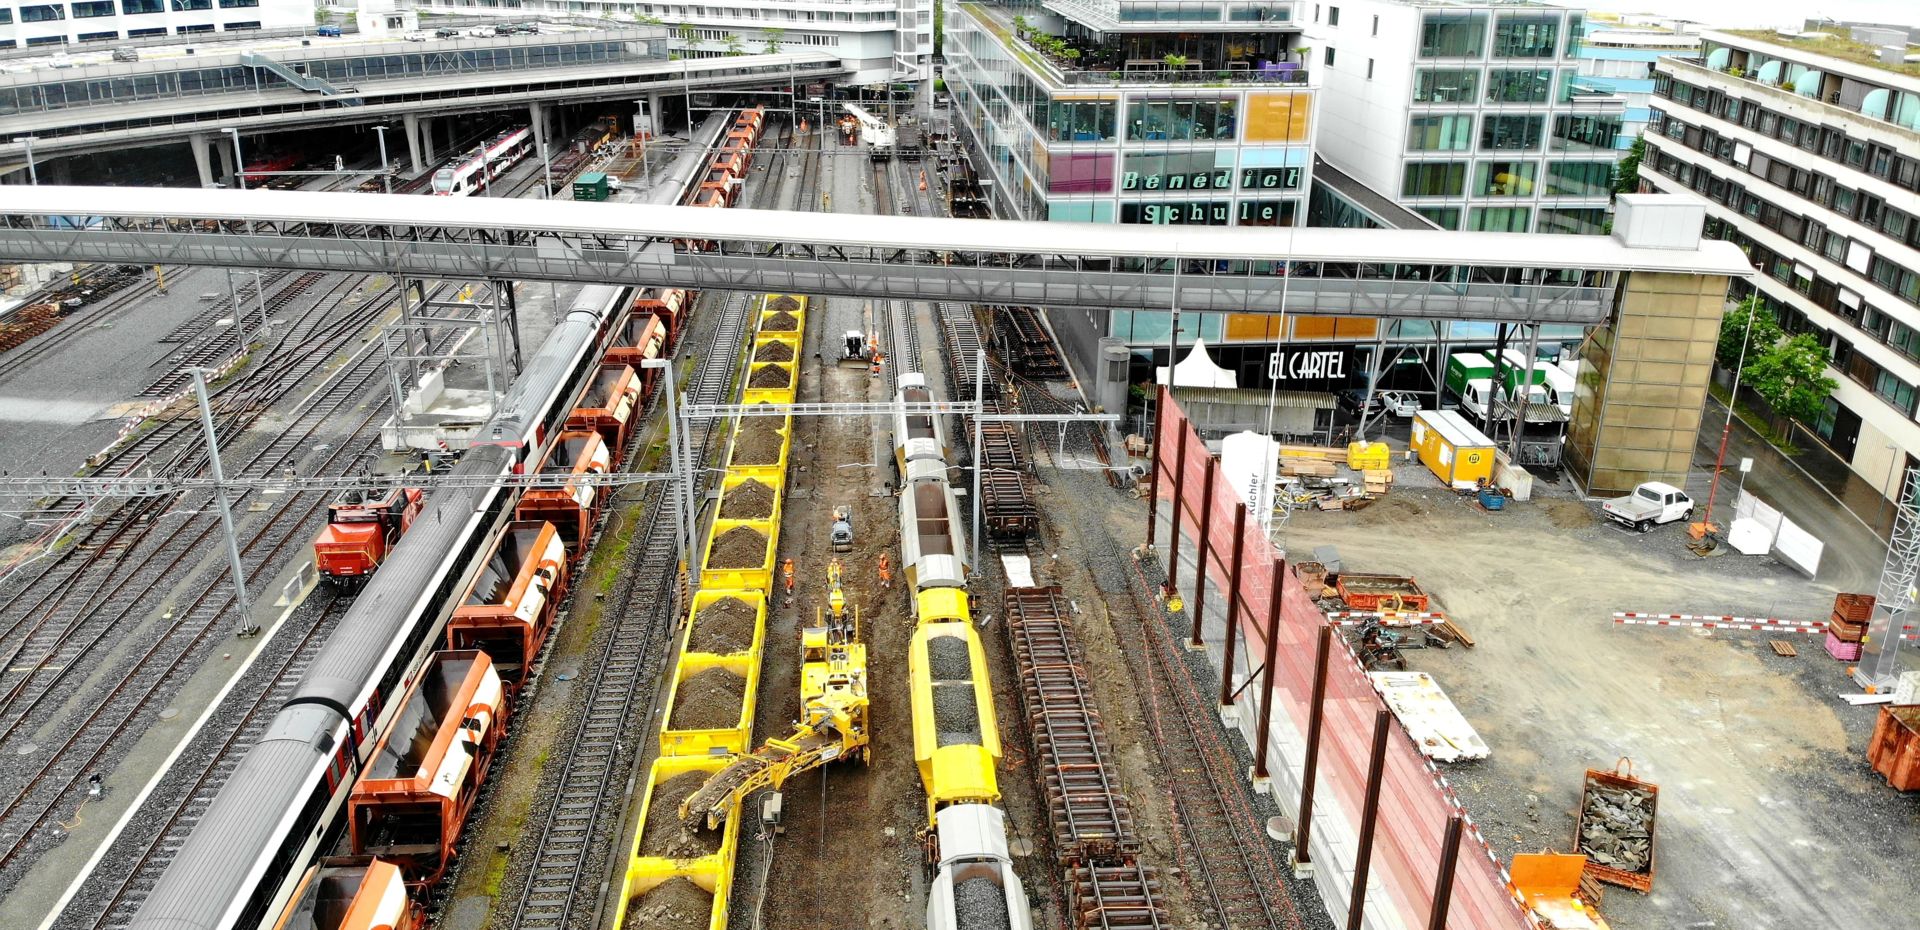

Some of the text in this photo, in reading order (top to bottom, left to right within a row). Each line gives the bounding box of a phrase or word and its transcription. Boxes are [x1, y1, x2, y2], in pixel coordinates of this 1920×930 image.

[1122, 169, 1299, 190] Bénédict
[1144, 202, 1273, 222] Schule
[1268, 351, 1346, 380] EL CARTEL
[1247, 473, 1259, 516] Küchler
